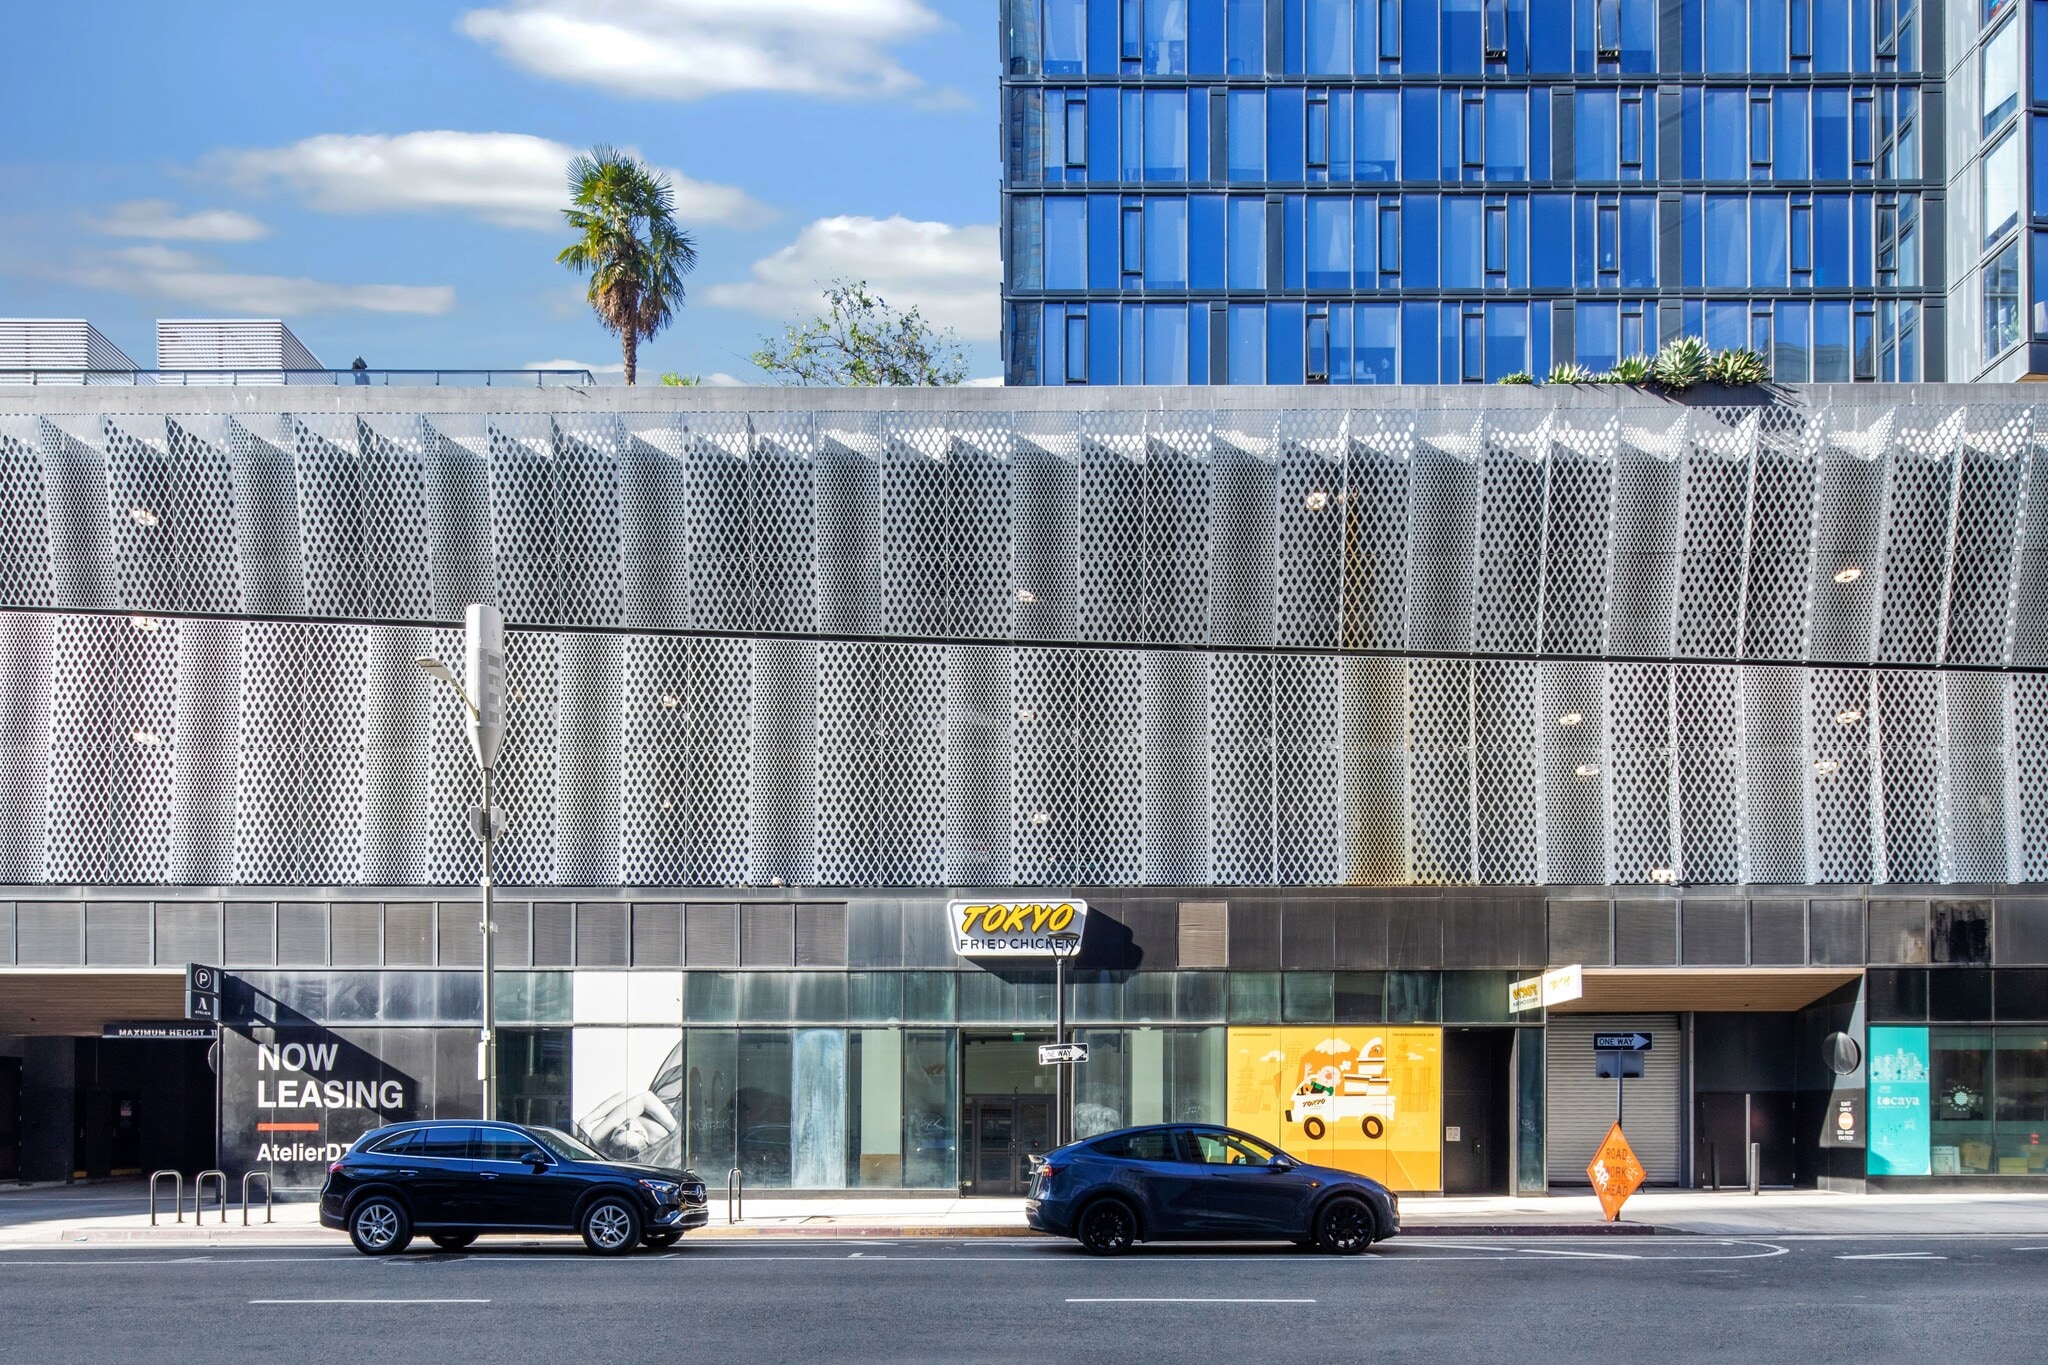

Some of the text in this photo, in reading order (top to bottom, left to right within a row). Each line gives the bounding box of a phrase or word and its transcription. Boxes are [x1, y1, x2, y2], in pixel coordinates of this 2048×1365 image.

[961, 903, 1075, 934] TOKYO
[960, 938, 1076, 950] FRIED CHICKEN
[199, 972, 208, 985] P
[119, 1029, 164, 1037] MAXIMUM
[169, 1029, 205, 1037] HEIGHT
[1599, 1038, 1633, 1046] ONE WAY
[257, 1043, 339, 1071] NOW
[1058, 1049, 1071, 1057] WAY
[257, 1080, 403, 1109] LEASING
[1877, 1096, 1920, 1109] tocaya
[1606, 1148, 1627, 1160] ROAD
[1607, 1166, 1626, 1178] ORK
